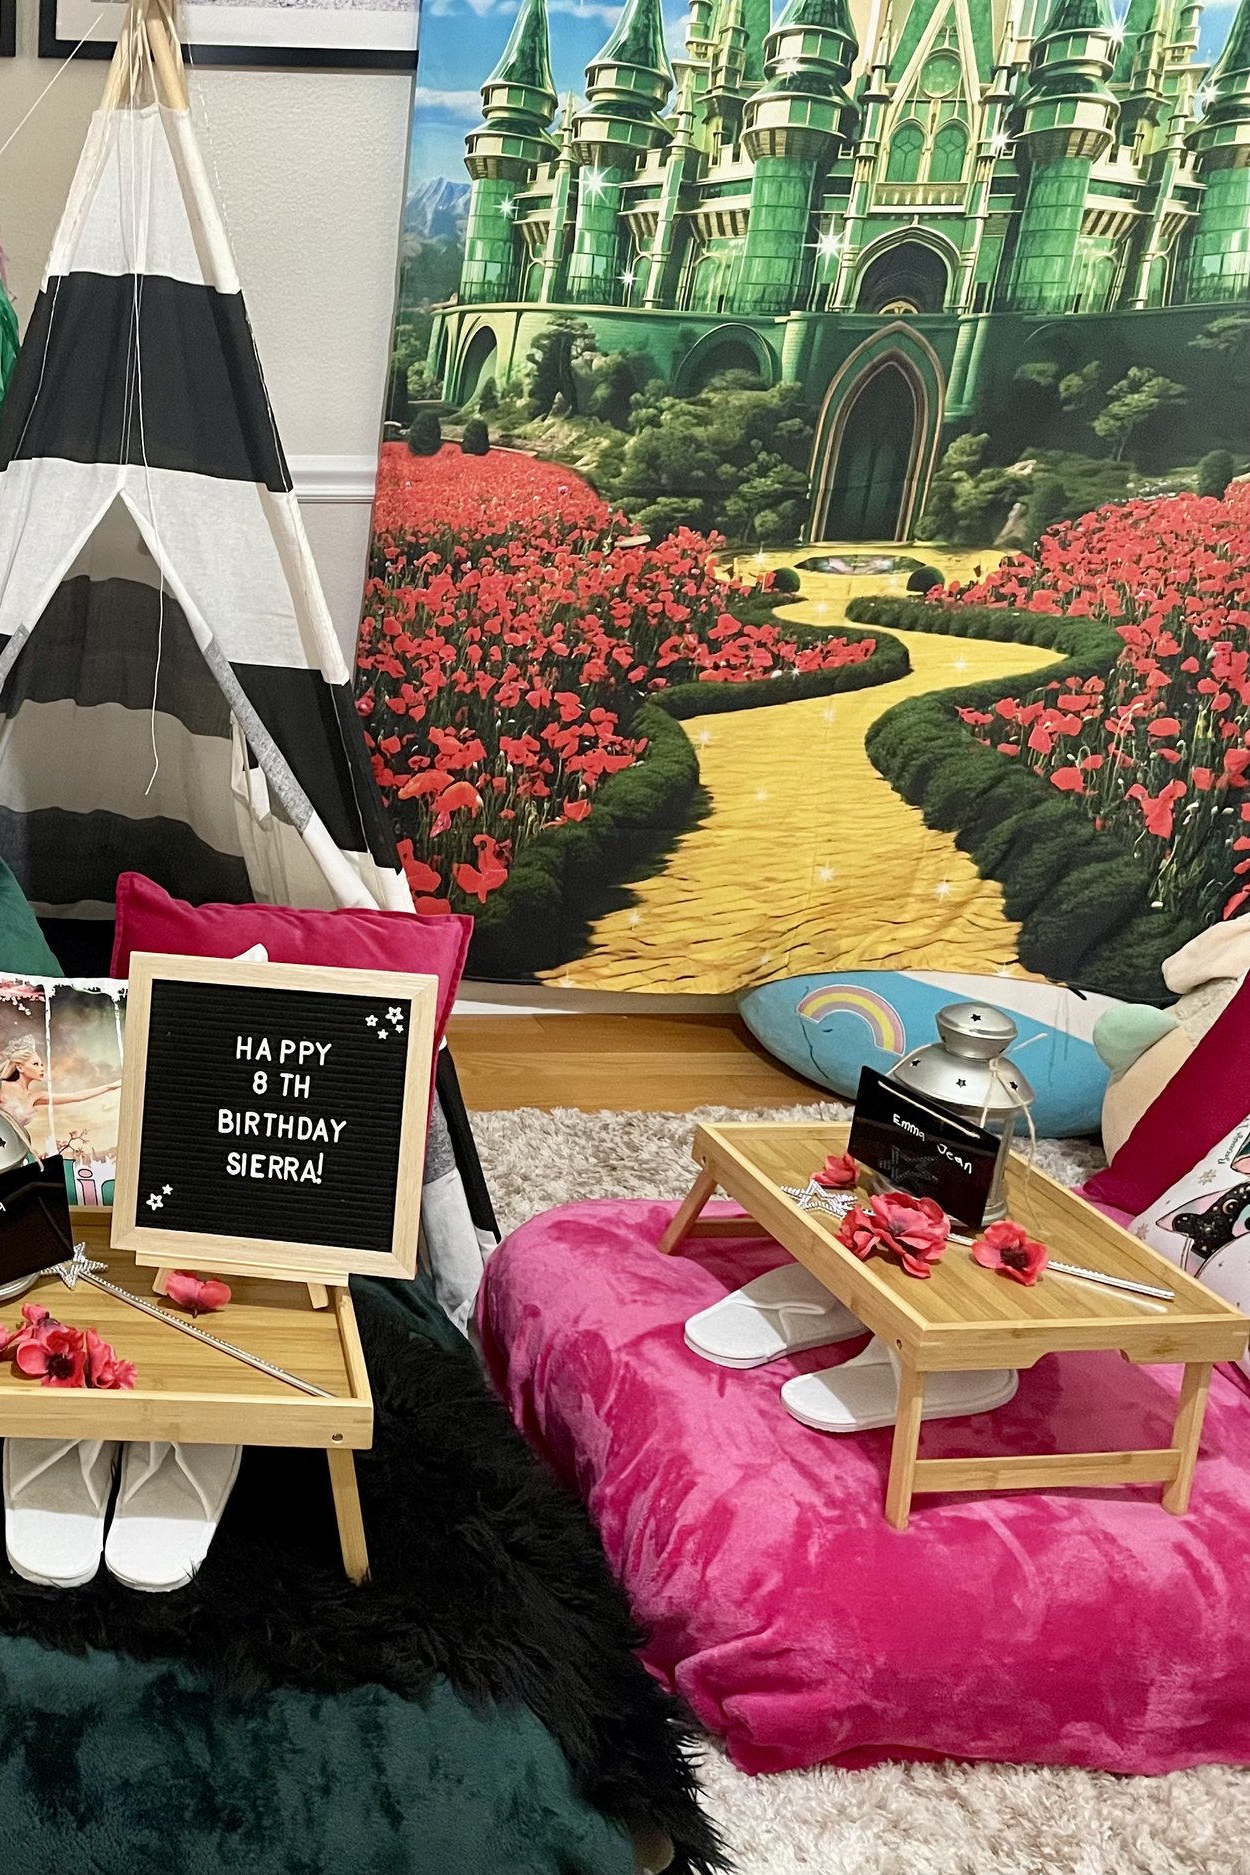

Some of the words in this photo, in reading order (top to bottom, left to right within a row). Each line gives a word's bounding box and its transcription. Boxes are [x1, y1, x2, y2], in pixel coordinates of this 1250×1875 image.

[236, 1036, 332, 1066] HAPPY
[252, 1071, 268, 1095] 8
[280, 1073, 310, 1098] TH
[218, 1109, 347, 1143] BIRTHDAY
[892, 1113, 926, 1142] Emma
[937, 1143, 973, 1174] Jean
[226, 1152, 324, 1185] SIERRA!
